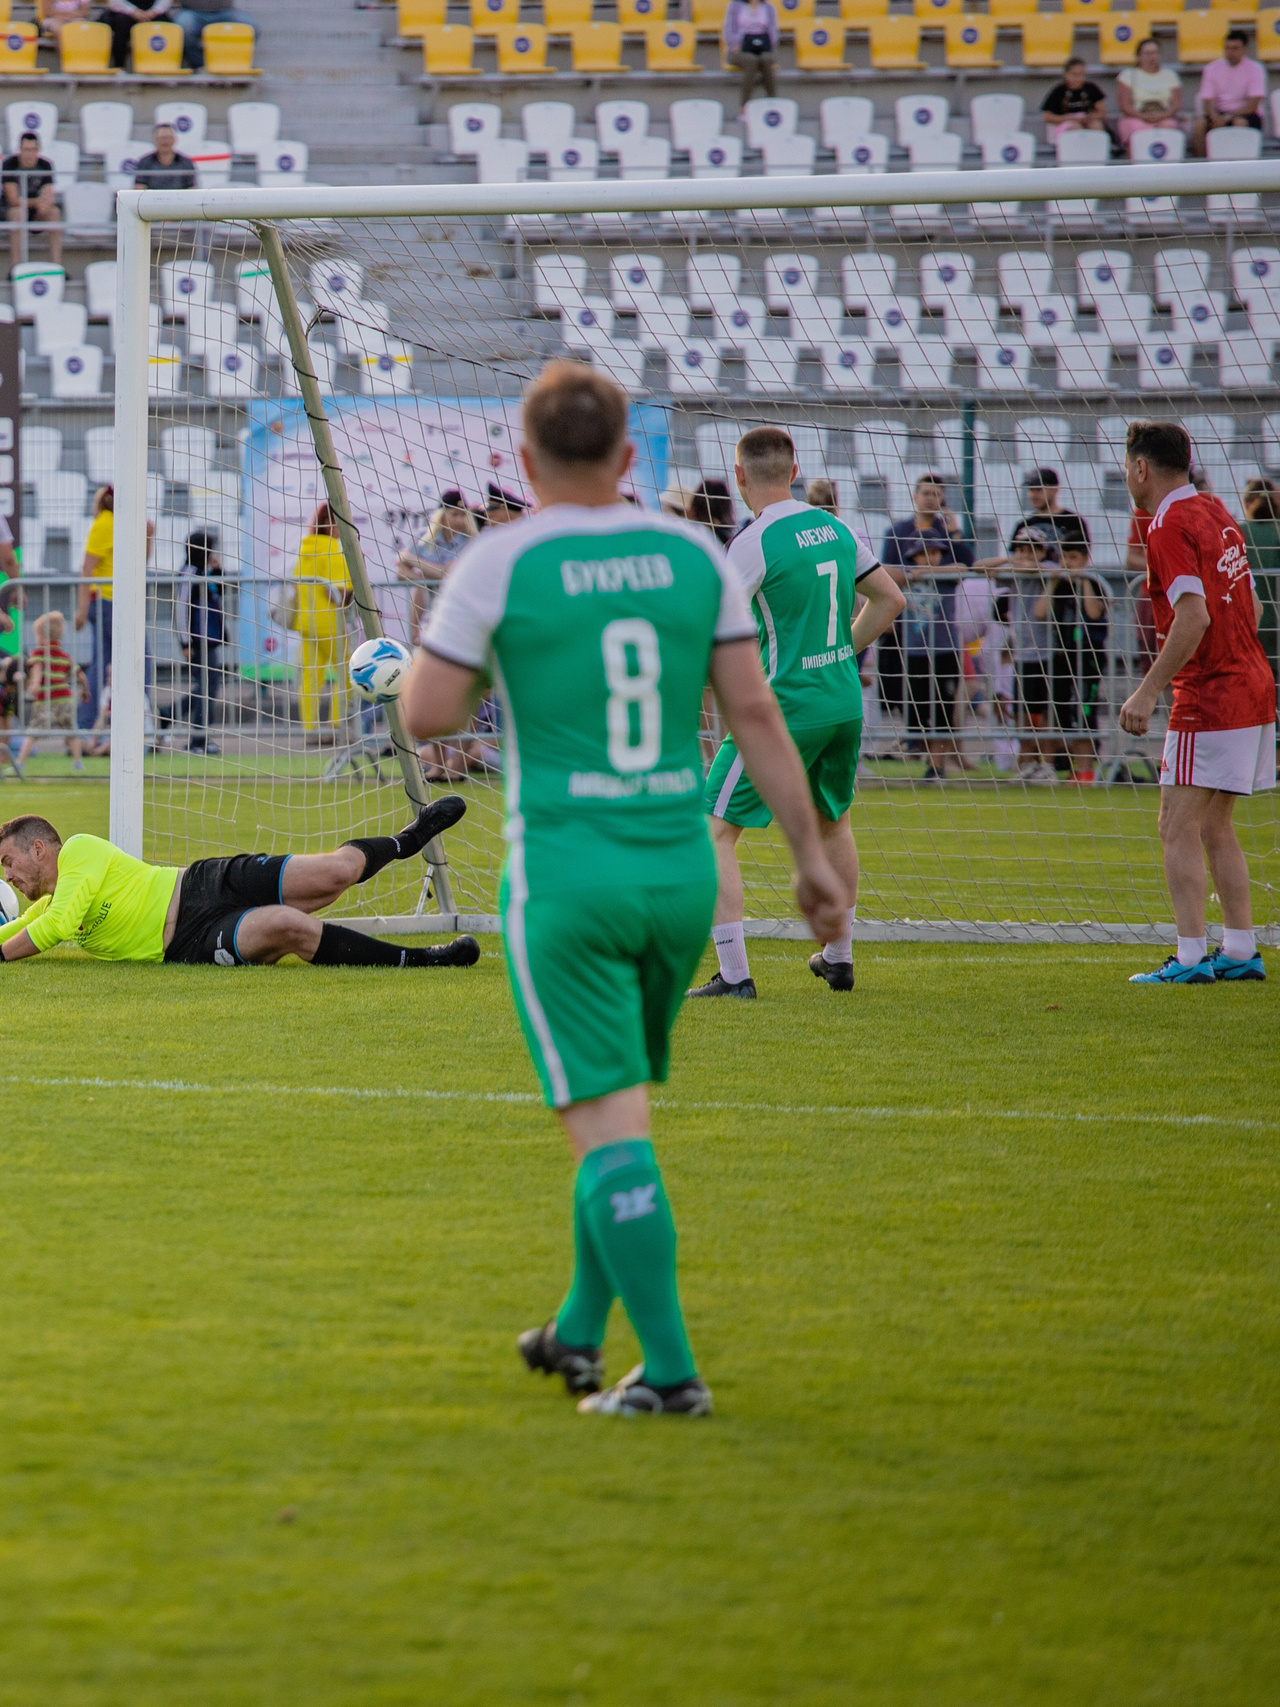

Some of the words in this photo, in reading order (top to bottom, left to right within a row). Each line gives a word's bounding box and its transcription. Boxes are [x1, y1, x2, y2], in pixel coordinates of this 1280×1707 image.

[794, 524, 839, 549] АЛЕХИН
[815, 559, 838, 647] 7
[601, 617, 662, 773] 8
